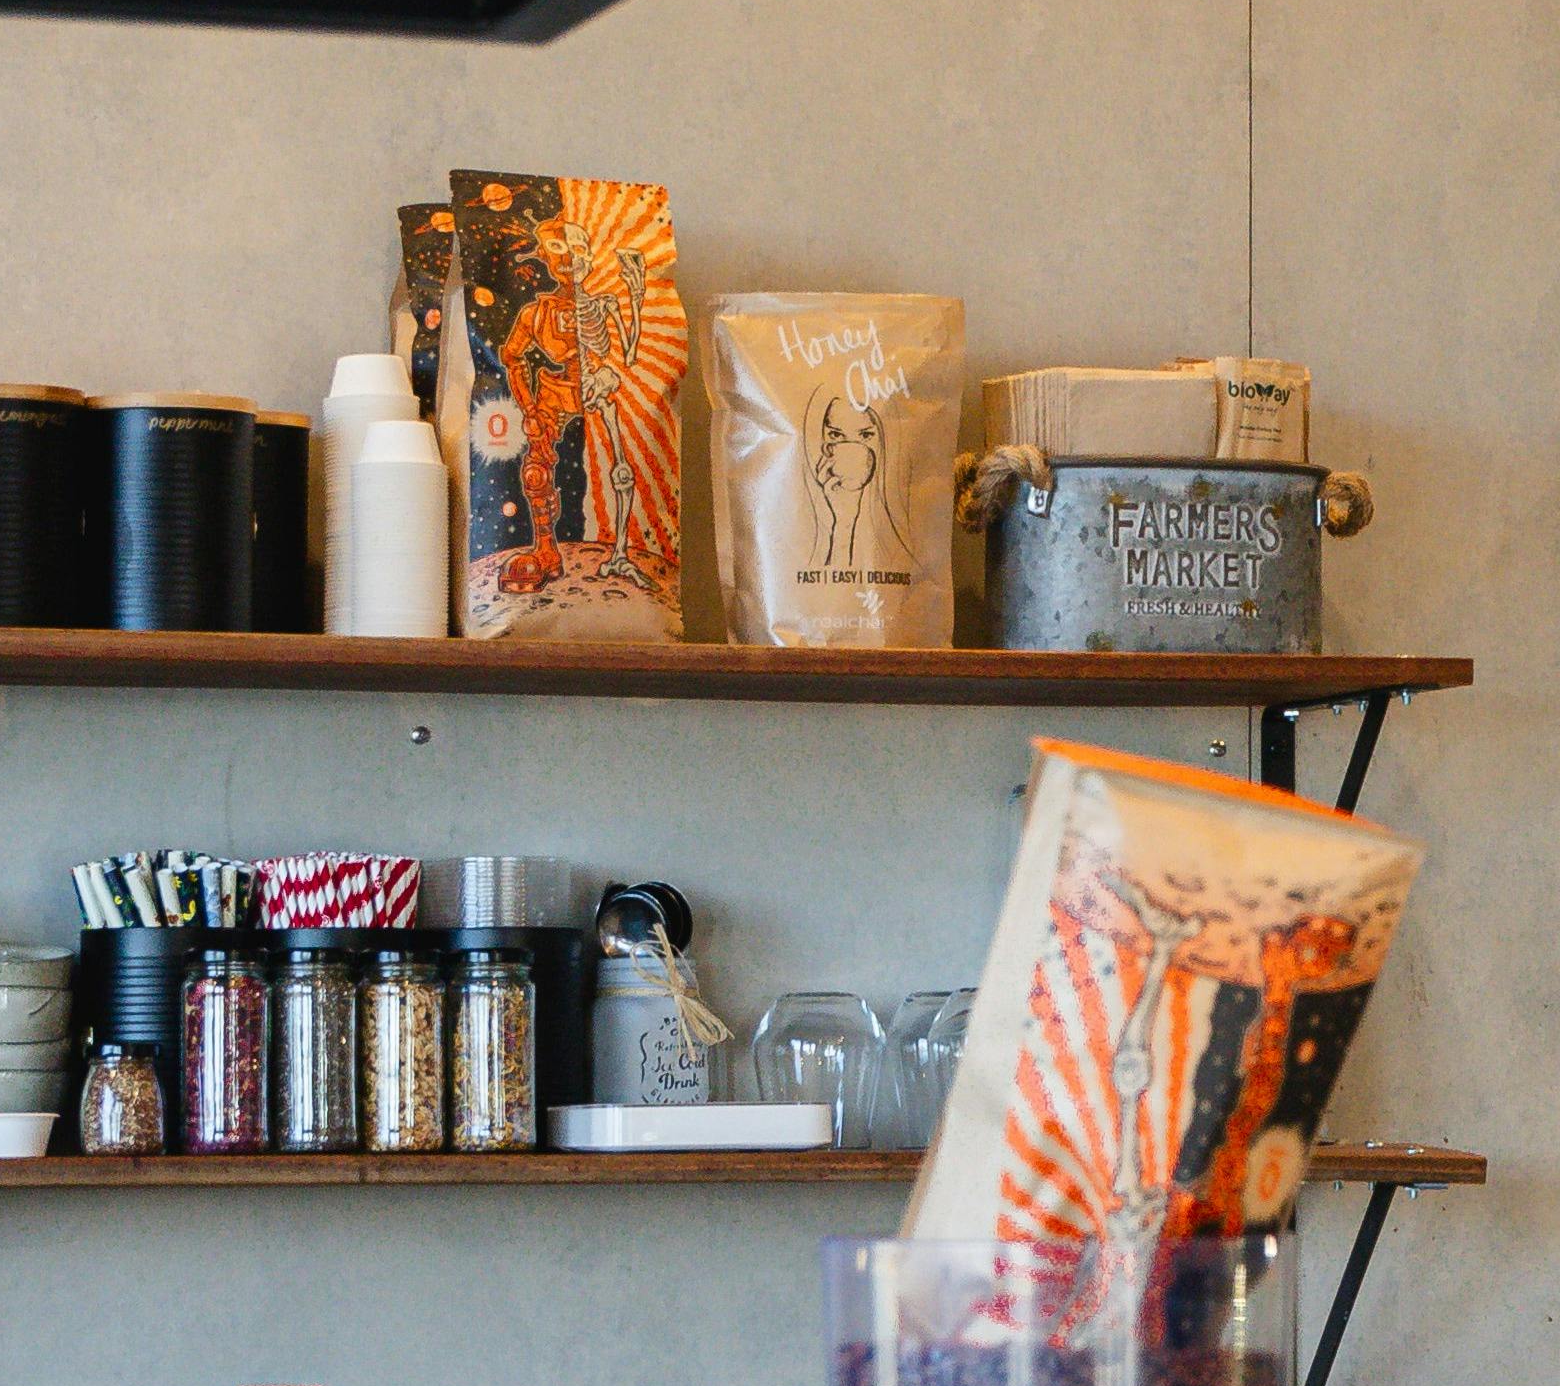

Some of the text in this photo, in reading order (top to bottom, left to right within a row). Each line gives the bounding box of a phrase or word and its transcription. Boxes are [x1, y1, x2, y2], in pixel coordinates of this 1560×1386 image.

[777, 319, 884, 372] Honey
[845, 355, 911, 413] Chai
[1109, 501, 1284, 554] FARMERS
[796, 570, 912, 586] FAST EASY DELICIOUS
[1125, 548, 1264, 590] MARKET
[1125, 599, 1175, 616] FRESH
[658, 1072, 700, 1090] Drink
